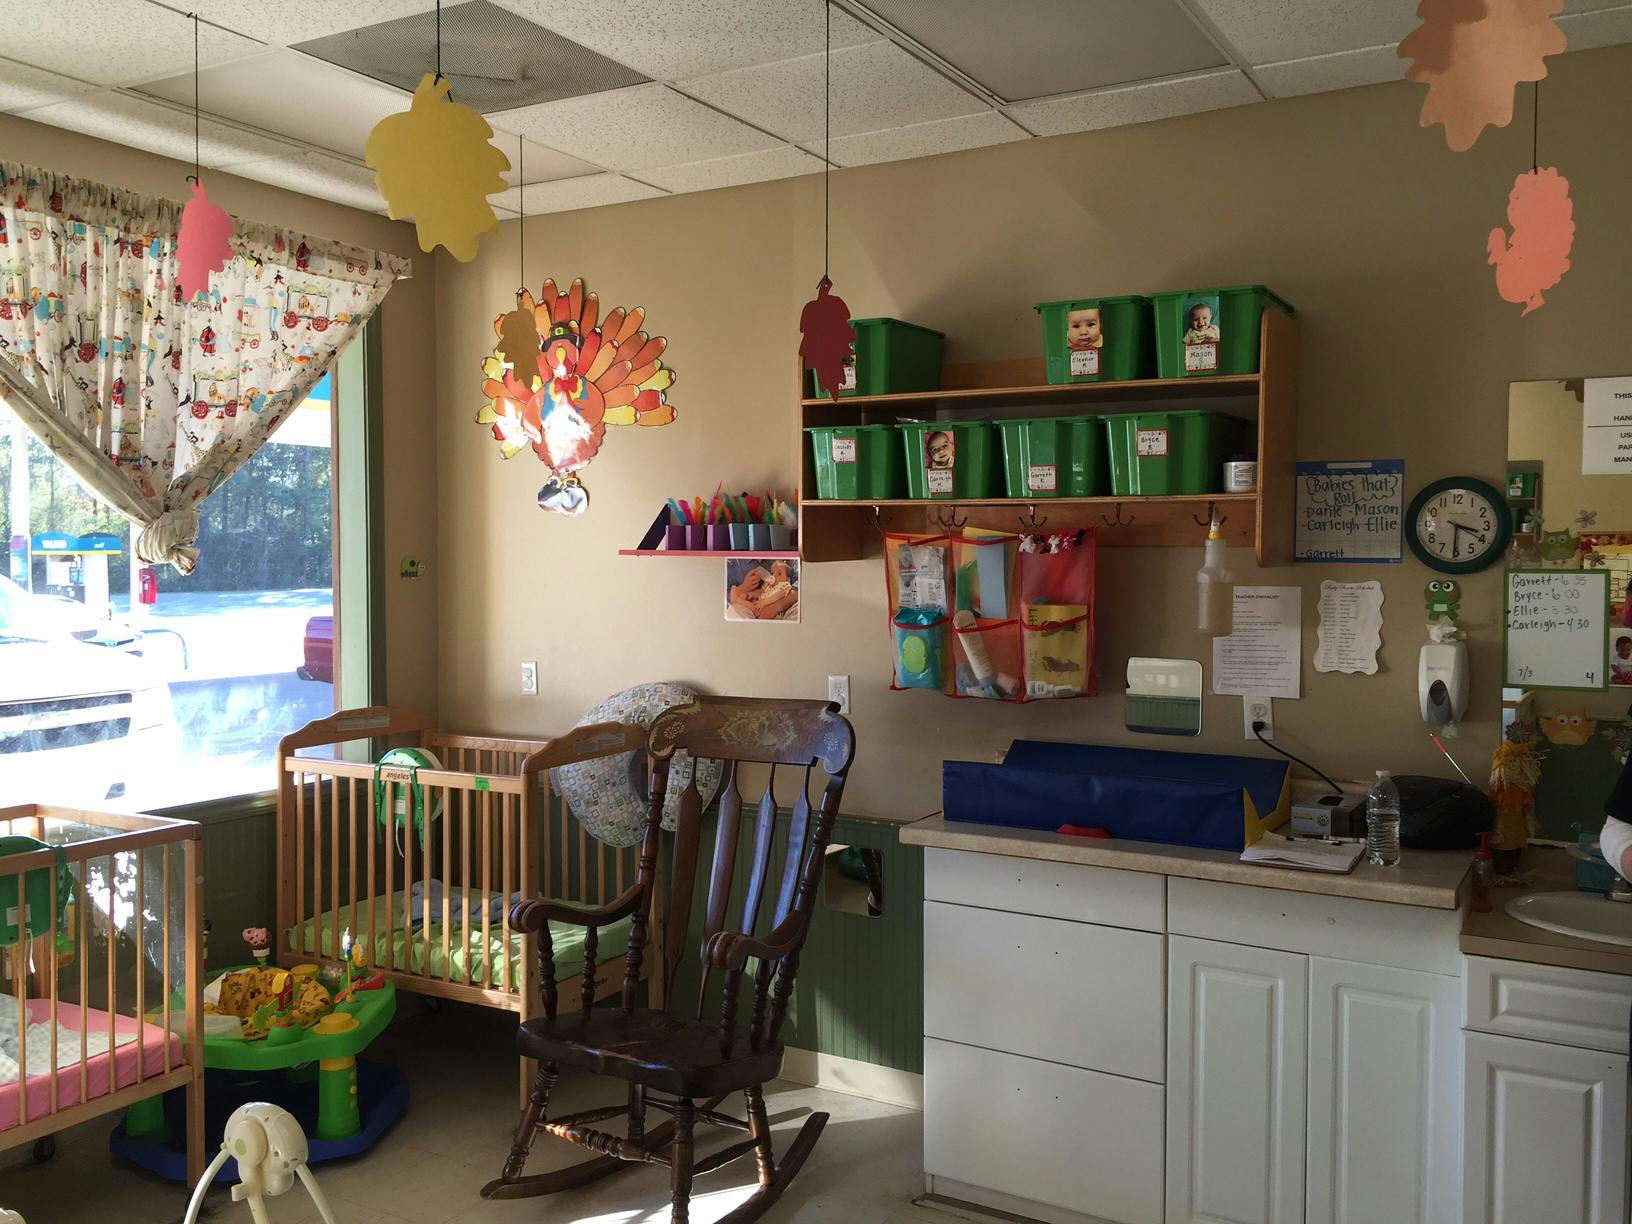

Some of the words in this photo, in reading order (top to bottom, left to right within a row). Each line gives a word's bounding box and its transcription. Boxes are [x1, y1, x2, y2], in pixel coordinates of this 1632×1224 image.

[1313, 479, 1354, 492] Babies
[1361, 476, 1391, 492] that
[1333, 492, 1355, 505] Roll
[1440, 497, 1447, 508] 11
[1453, 493, 1463, 505] 12
[1470, 497, 1474, 508] 1
[1479, 507, 1487, 518] 2
[1482, 520, 1490, 531] 3
[1428, 533, 1436, 544] 8
[1478, 534, 1486, 545] 4
[1439, 543, 1446, 553] 7
[1468, 543, 1475, 554] 5
[386, 772, 410, 780] angeles
